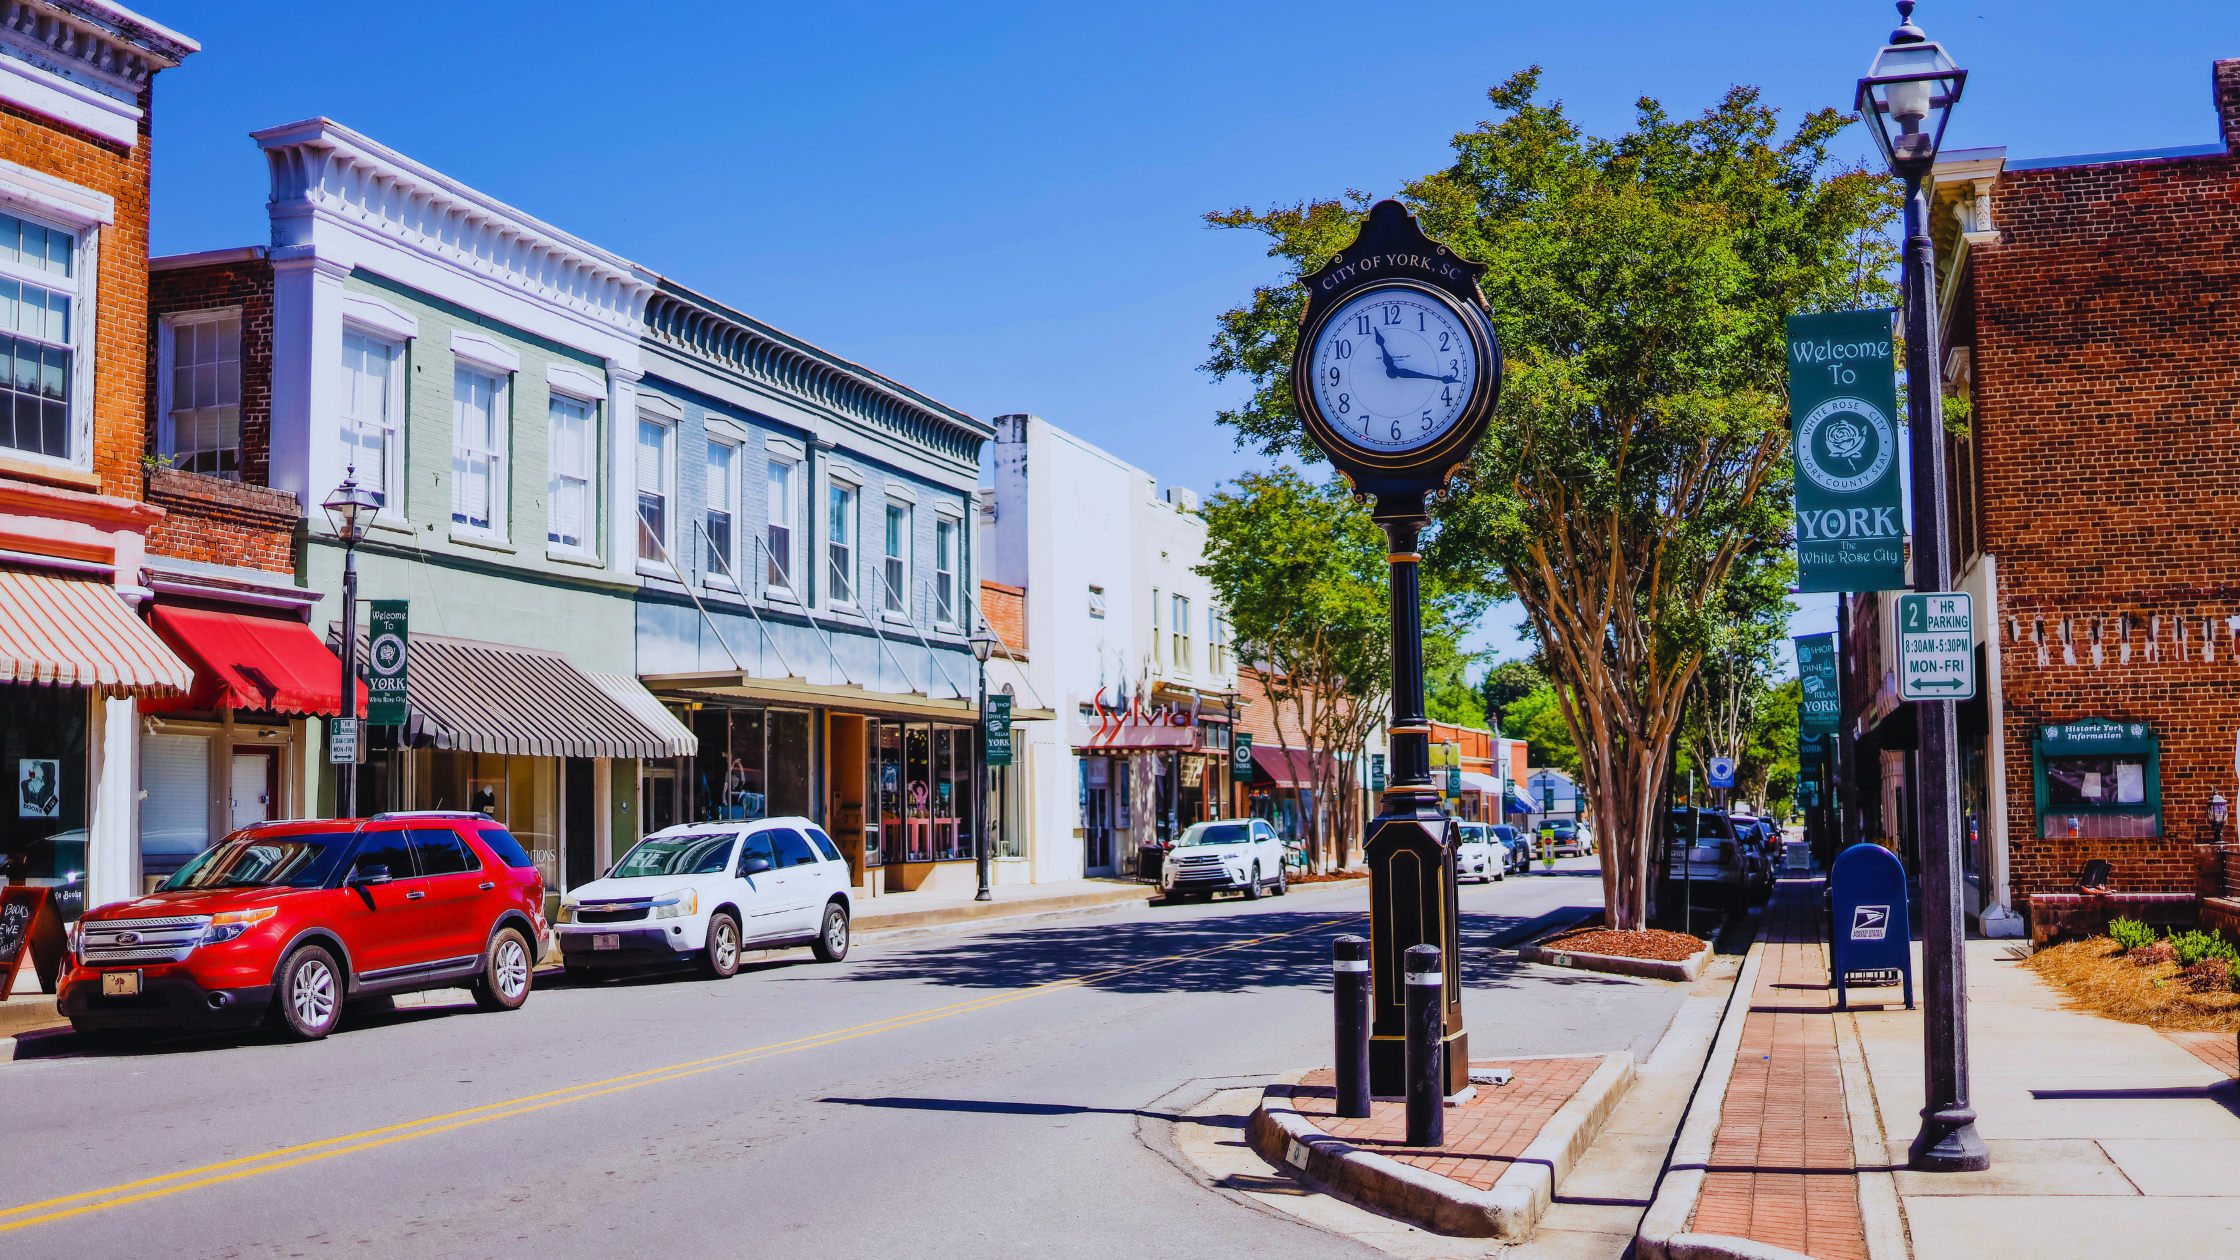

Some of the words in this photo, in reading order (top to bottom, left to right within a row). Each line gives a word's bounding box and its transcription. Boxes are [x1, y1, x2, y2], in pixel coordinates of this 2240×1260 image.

[1322, 262, 1356, 290] CITY
[1360, 256, 1380, 270] OF
[1386, 254, 1436, 272] YORK,
[1440, 262, 1460, 280] SC
[1382, 304, 1402, 325] 12
[1418, 312, 1426, 332] 1
[1356, 315, 1372, 336] 11
[1335, 340, 1351, 360] 10
[1439, 332, 1451, 352] 2
[1793, 339, 1890, 363] Welcome
[1329, 367, 1340, 386] 9
[1450, 358, 1458, 379] 3
[1828, 362, 1856, 385] To
[1339, 393, 1350, 414] 8
[1440, 386, 1452, 407] 4
[1357, 415, 1370, 435] 7
[1421, 409, 1433, 430] 5
[1803, 407, 1828, 435] WHITE
[1832, 402, 1860, 410] ROSE
[1869, 411, 1887, 431] CITY
[1390, 420, 1401, 440] 6
[1803, 456, 1825, 480] YORK
[1826, 475, 1869, 488] COUNTY
[1871, 452, 1888, 475] SEAT
[1797, 506, 1899, 538] YORK
[1840, 541, 1856, 550] The
[1801, 552, 1836, 564] White
[1838, 550, 1870, 564] Rose
[1873, 548, 1898, 564] City
[372, 611, 406, 620] Welcome
[1909, 602, 1918, 626] 2
[1940, 600, 1955, 613] HR
[1928, 615, 1968, 628] PARKING
[384, 621, 394, 630] To
[1811, 645, 1832, 654] SHOP
[1803, 664, 1822, 672] DINE
[370, 678, 406, 689] YORK
[1094, 686, 1192, 744] Sylvia
[1804, 700, 1838, 712] YORK
[334, 722, 338, 733] 2
[2068, 732, 2121, 740] Information
[2103, 724, 2124, 733] York
[23, 803, 42, 813] BOOKS
[63, 890, 81, 900] Books
[4, 903, 28, 917] BOOKS
